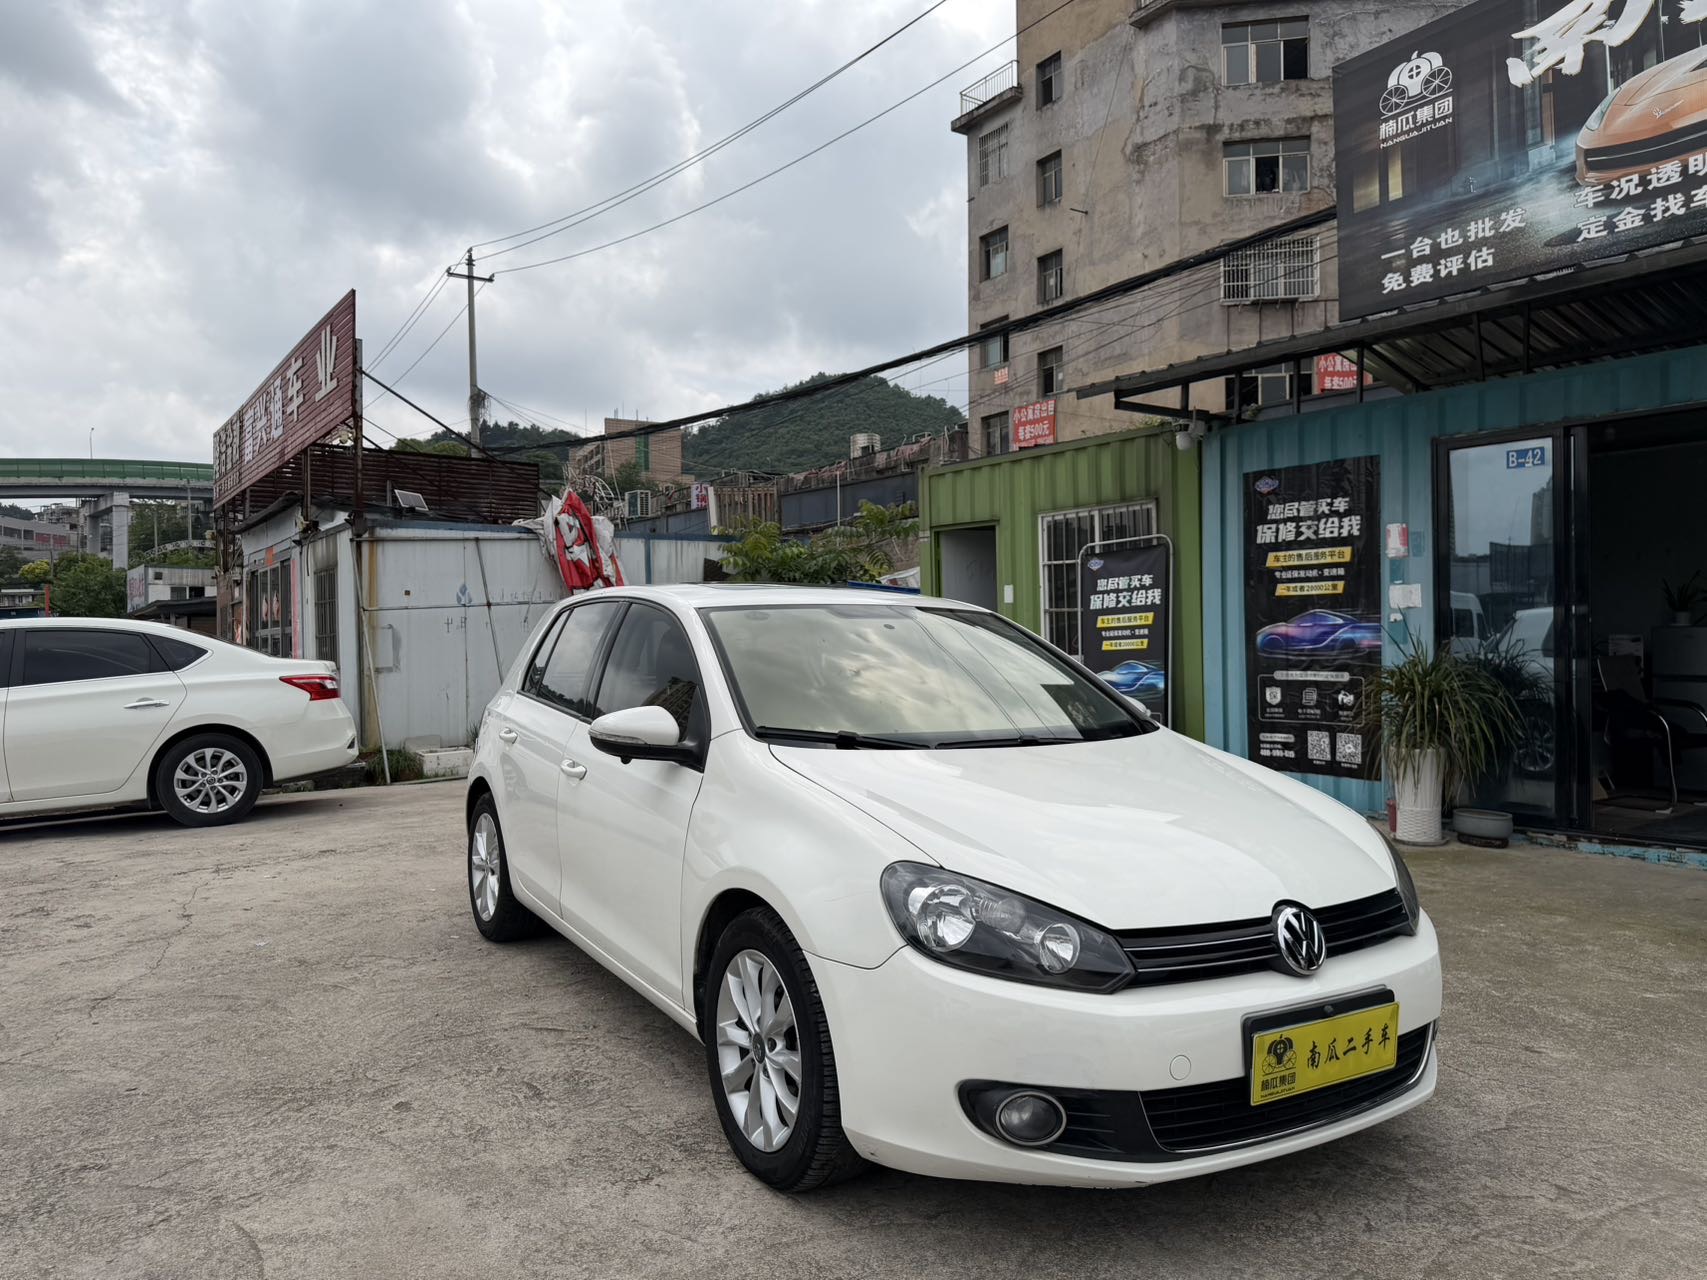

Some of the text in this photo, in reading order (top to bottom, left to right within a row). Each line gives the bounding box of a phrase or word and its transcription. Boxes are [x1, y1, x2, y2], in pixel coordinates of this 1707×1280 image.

[1379, 96, 1453, 140] 楠瓜集团
[1381, 208, 1526, 259] 一台也批发
[1381, 246, 1495, 294] 免费评估
[1509, 449, 1542, 467] B-42
[1267, 497, 1349, 519] 您尽管买车
[1256, 515, 1361, 544] 保修交给我
[1273, 549, 1345, 563] 车主的售后服务平台
[1096, 574, 1153, 591] 您尽管买车
[1090, 588, 1162, 610] 保修交给我
[1306, 1022, 1391, 1070] 南瓜二手车
